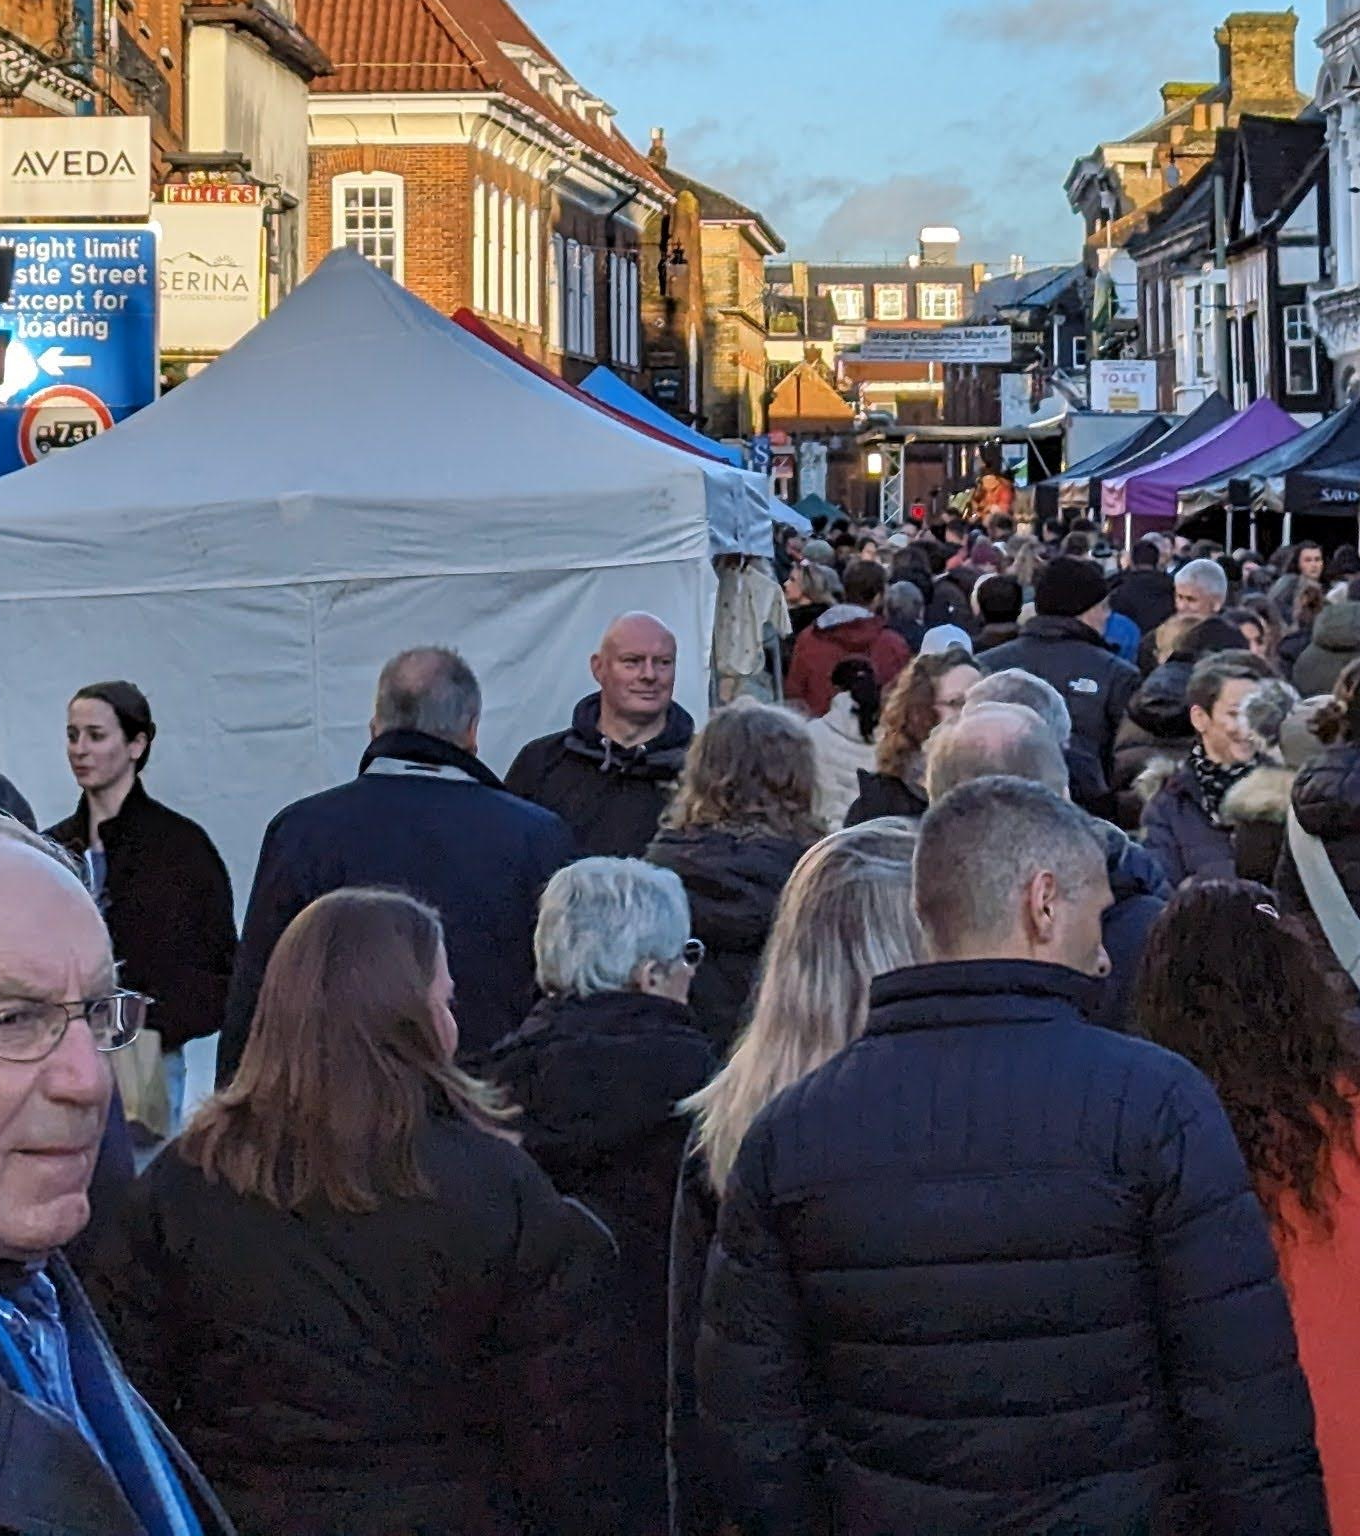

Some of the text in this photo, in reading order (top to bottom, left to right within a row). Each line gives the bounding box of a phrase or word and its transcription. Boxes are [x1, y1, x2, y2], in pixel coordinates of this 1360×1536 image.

[11, 150, 136, 176] AVEDA
[85, 236, 140, 258] limit
[15, 263, 148, 284] stle Street
[93, 289, 128, 310] for
[17, 313, 109, 340] loading
[1101, 373, 1146, 383] TO LET
